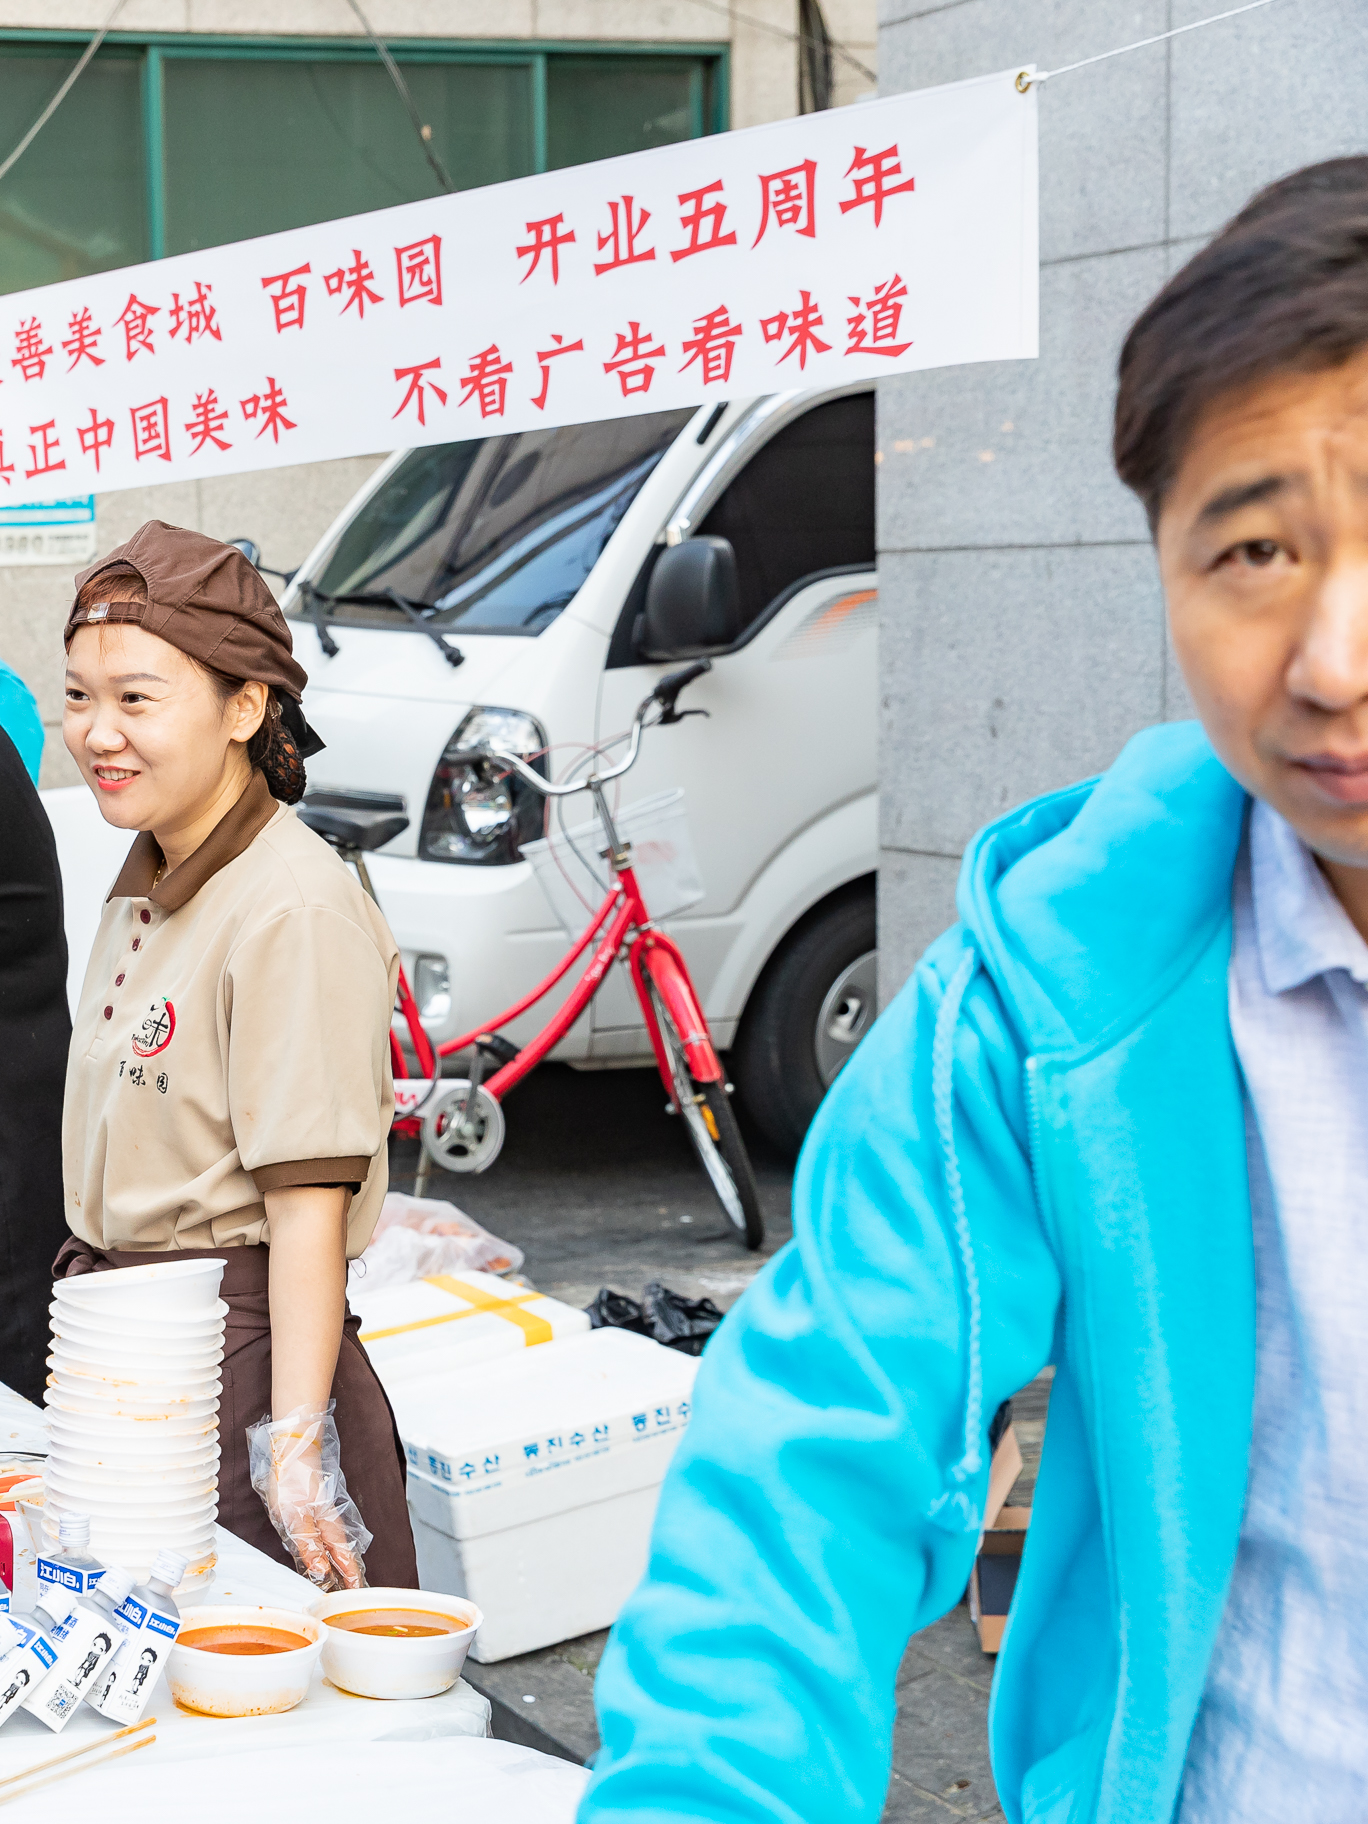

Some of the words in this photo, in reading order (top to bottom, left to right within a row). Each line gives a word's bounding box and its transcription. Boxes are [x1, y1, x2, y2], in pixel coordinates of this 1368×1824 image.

[261, 234, 443, 334] 百味园
[516, 143, 916, 285] 开业五周年
[392, 273, 914, 426] 不看广告看味道
[39, 1562, 81, 1589] 江小白
[149, 1617, 176, 1636] 江小白
[34, 1640, 53, 1667] 江小白
